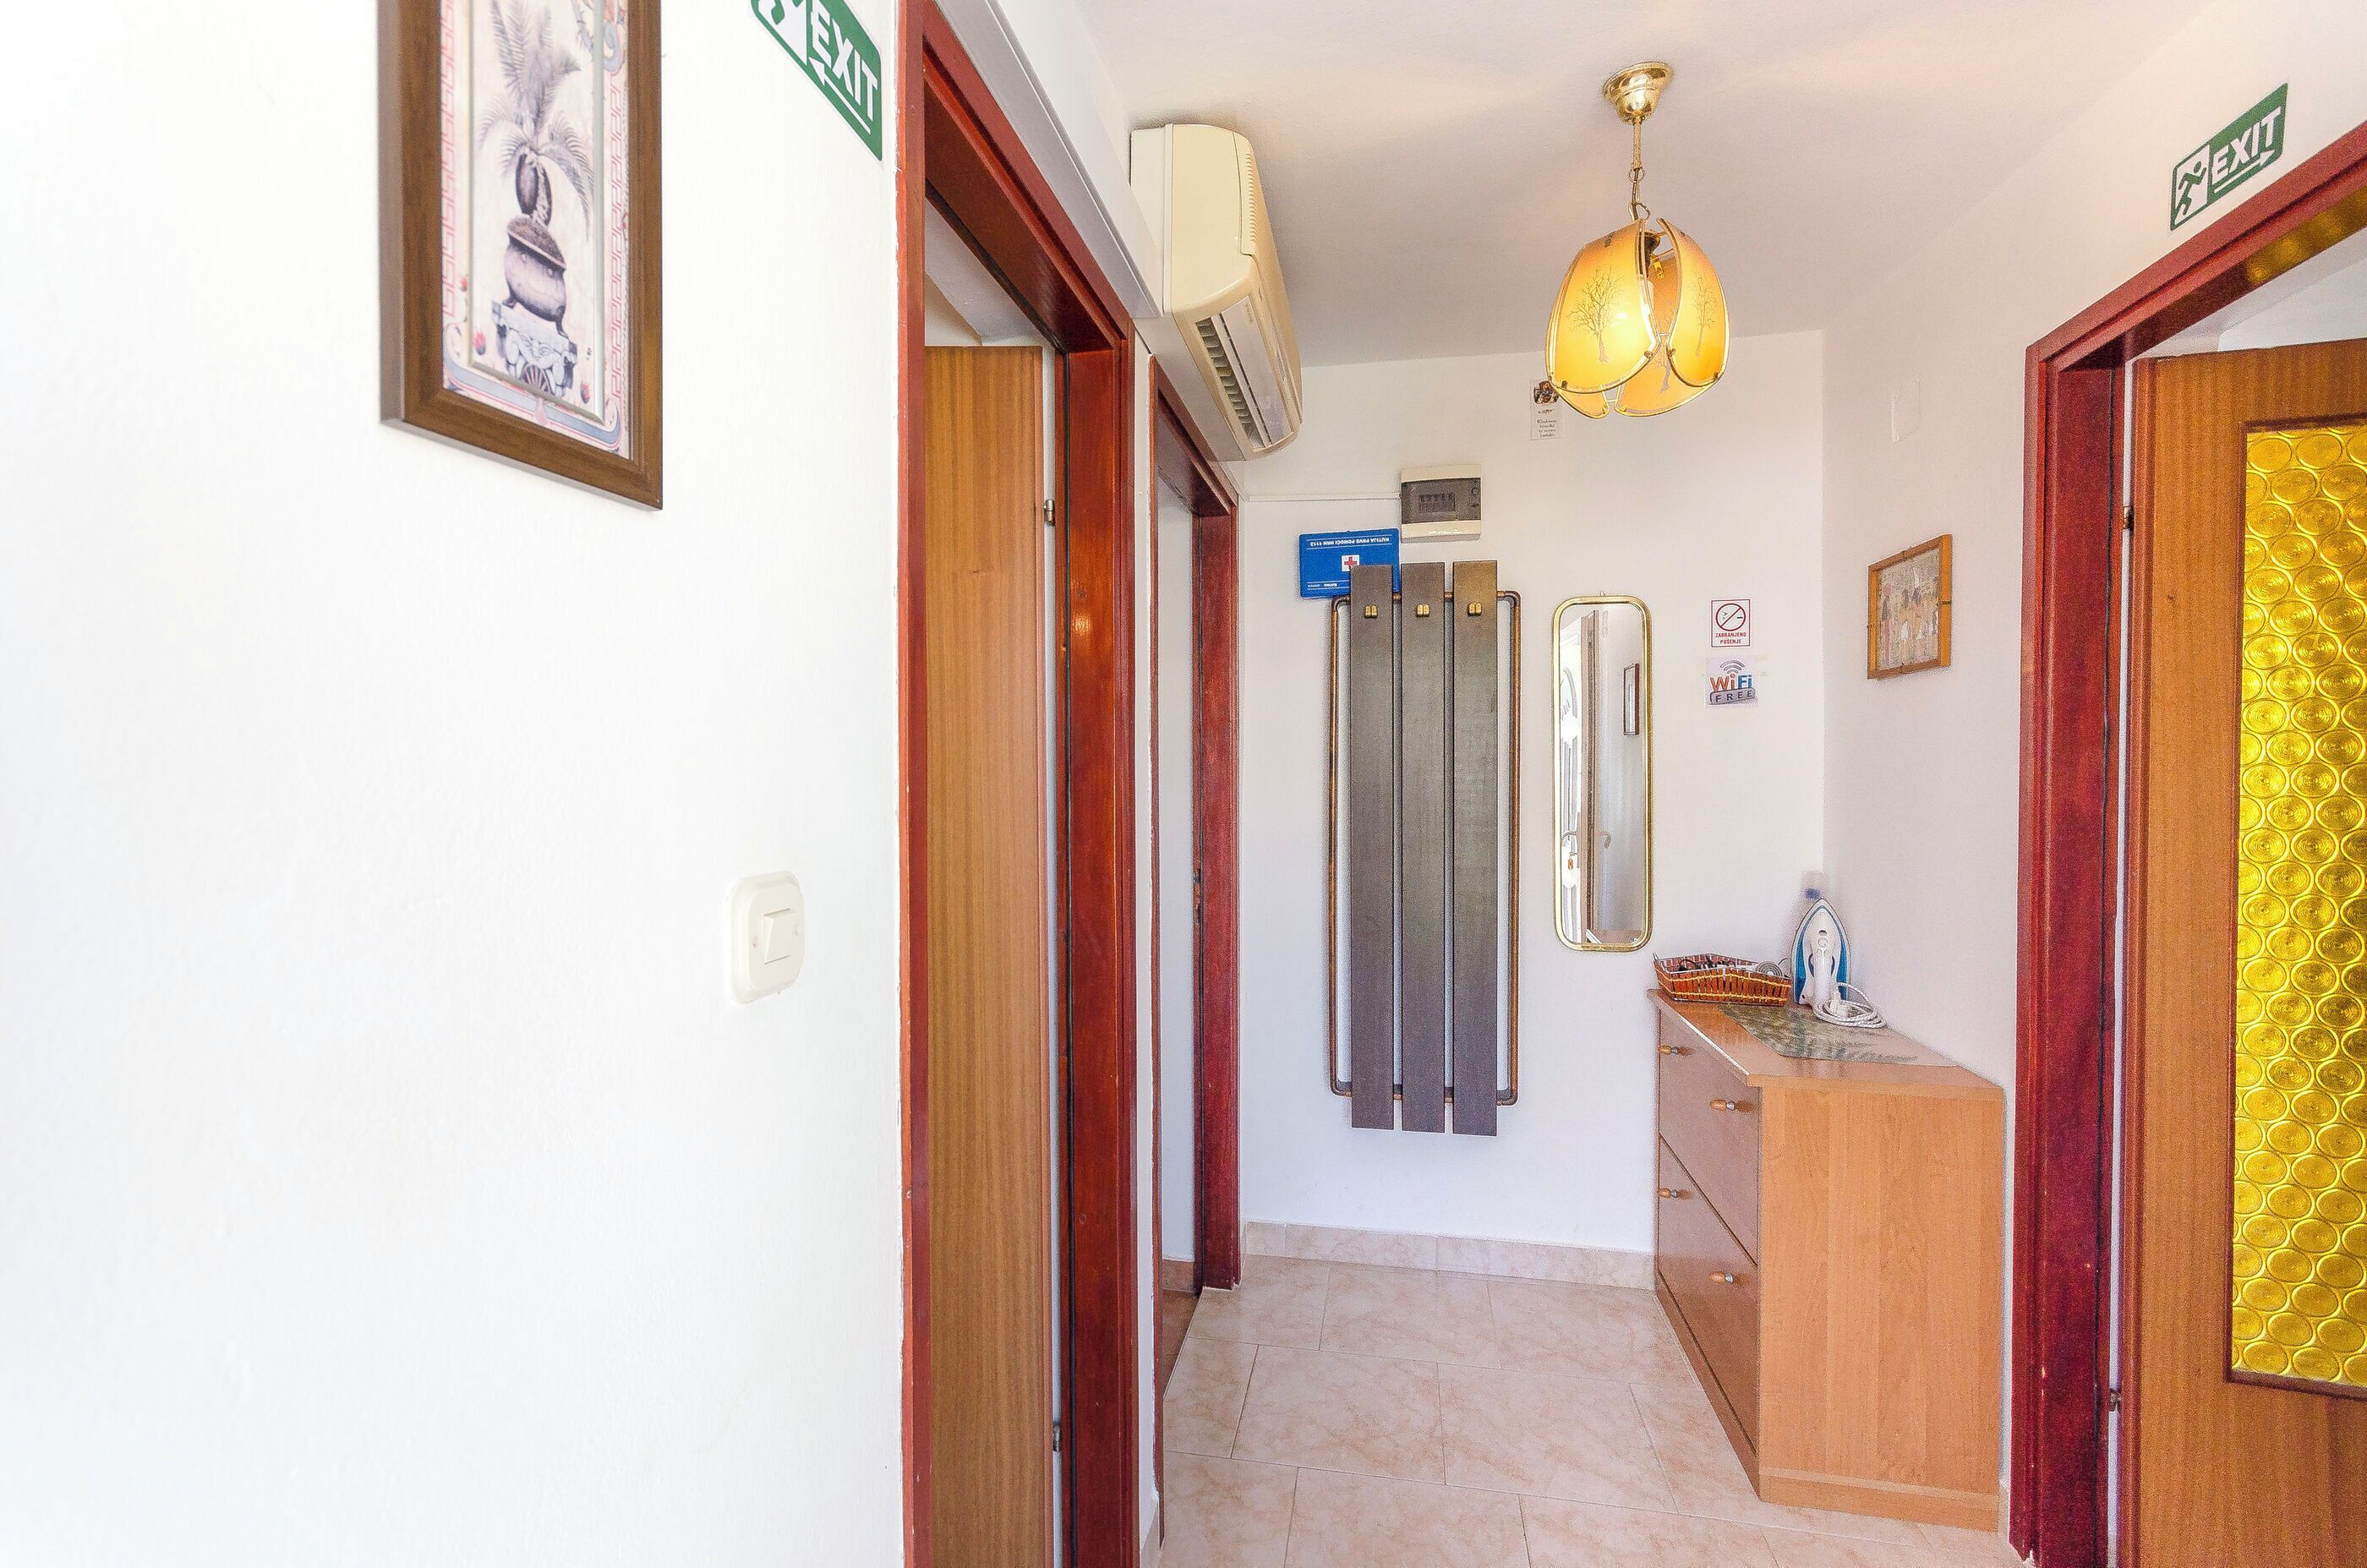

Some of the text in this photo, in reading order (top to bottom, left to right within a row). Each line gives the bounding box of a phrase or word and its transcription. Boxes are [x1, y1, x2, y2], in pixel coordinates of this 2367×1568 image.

[810, 0, 877, 122] EXIT
[2211, 106, 2282, 185] EXIT
[1709, 674, 1752, 692] WiFi
[1715, 690, 1752, 703] FREE
